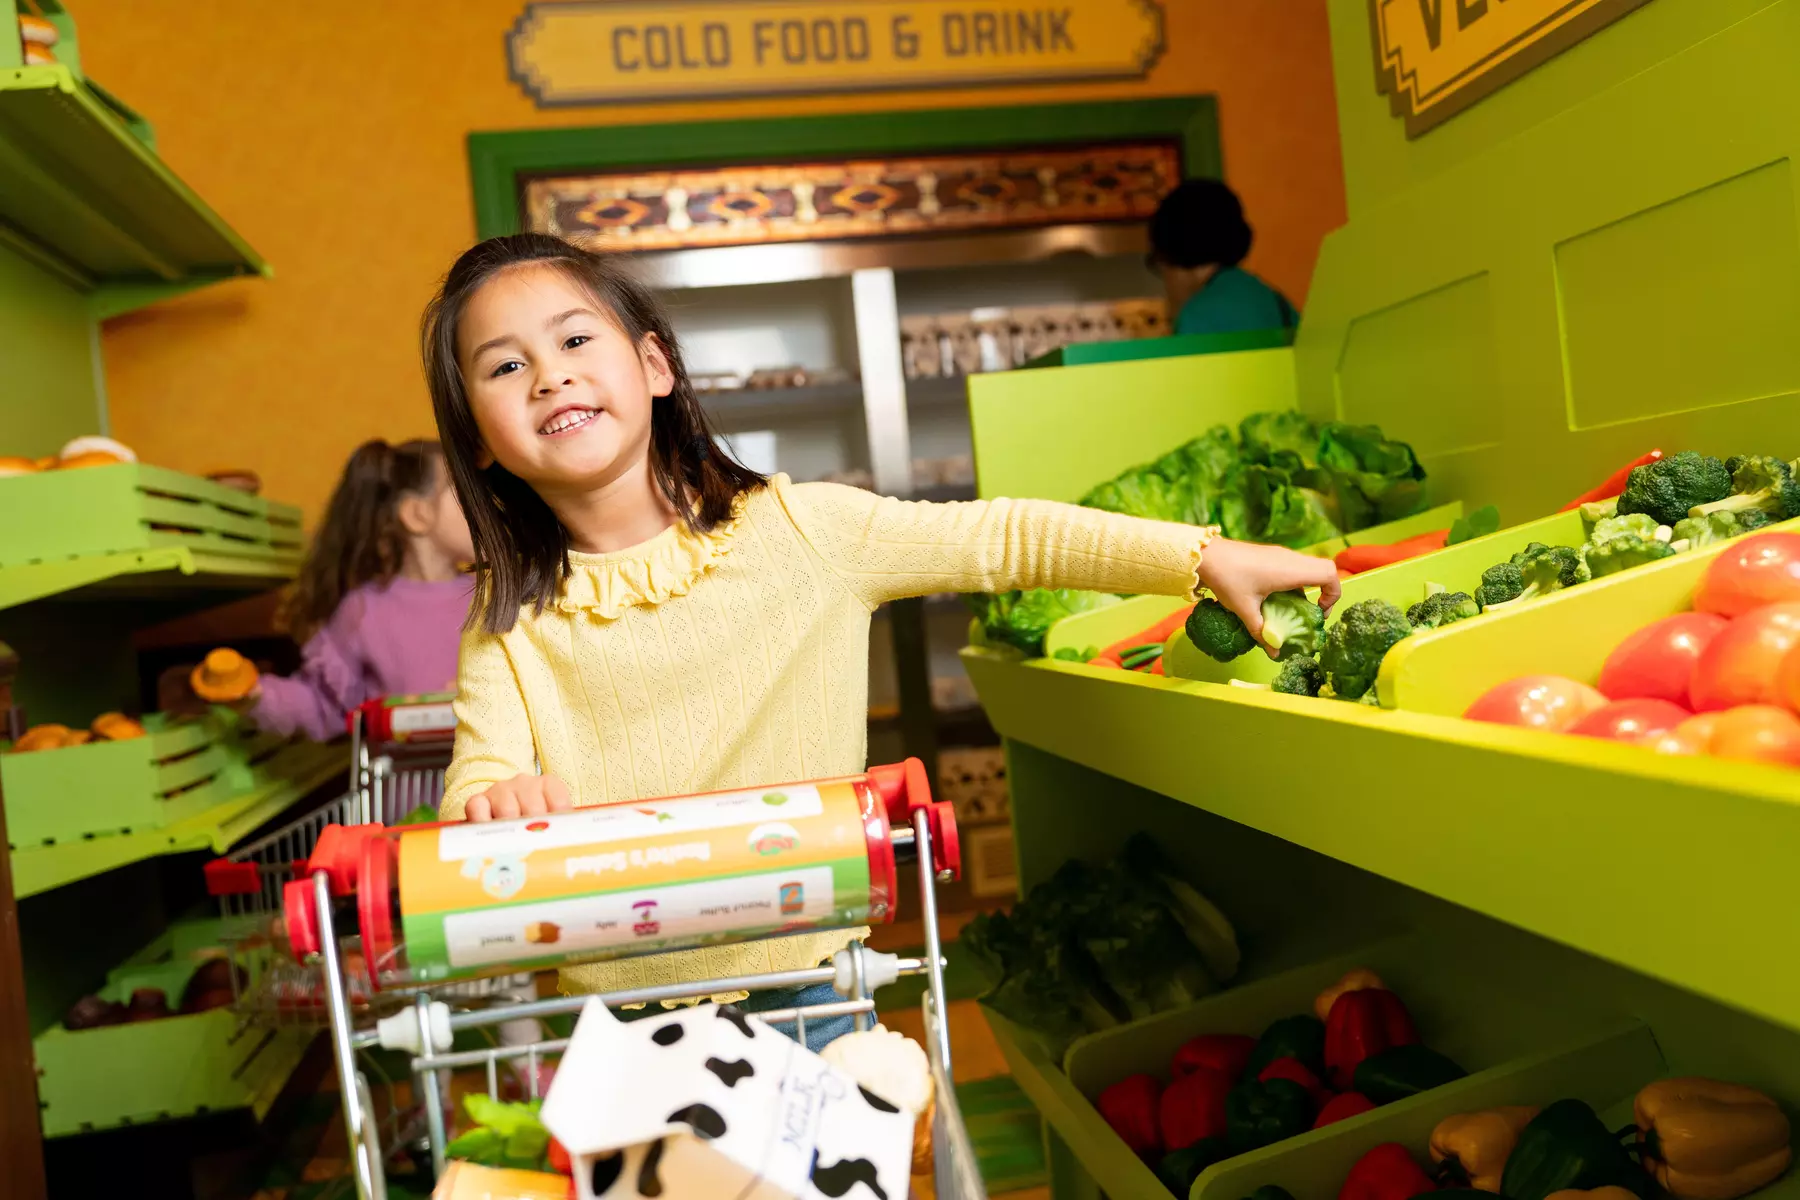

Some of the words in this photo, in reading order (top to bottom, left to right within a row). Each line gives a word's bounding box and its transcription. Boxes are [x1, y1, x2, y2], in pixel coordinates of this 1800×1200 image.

[611, 22, 732, 73] COLD
[753, 16, 871, 67] FOOD
[891, 13, 920, 60] &
[942, 7, 1077, 57] DRINK
